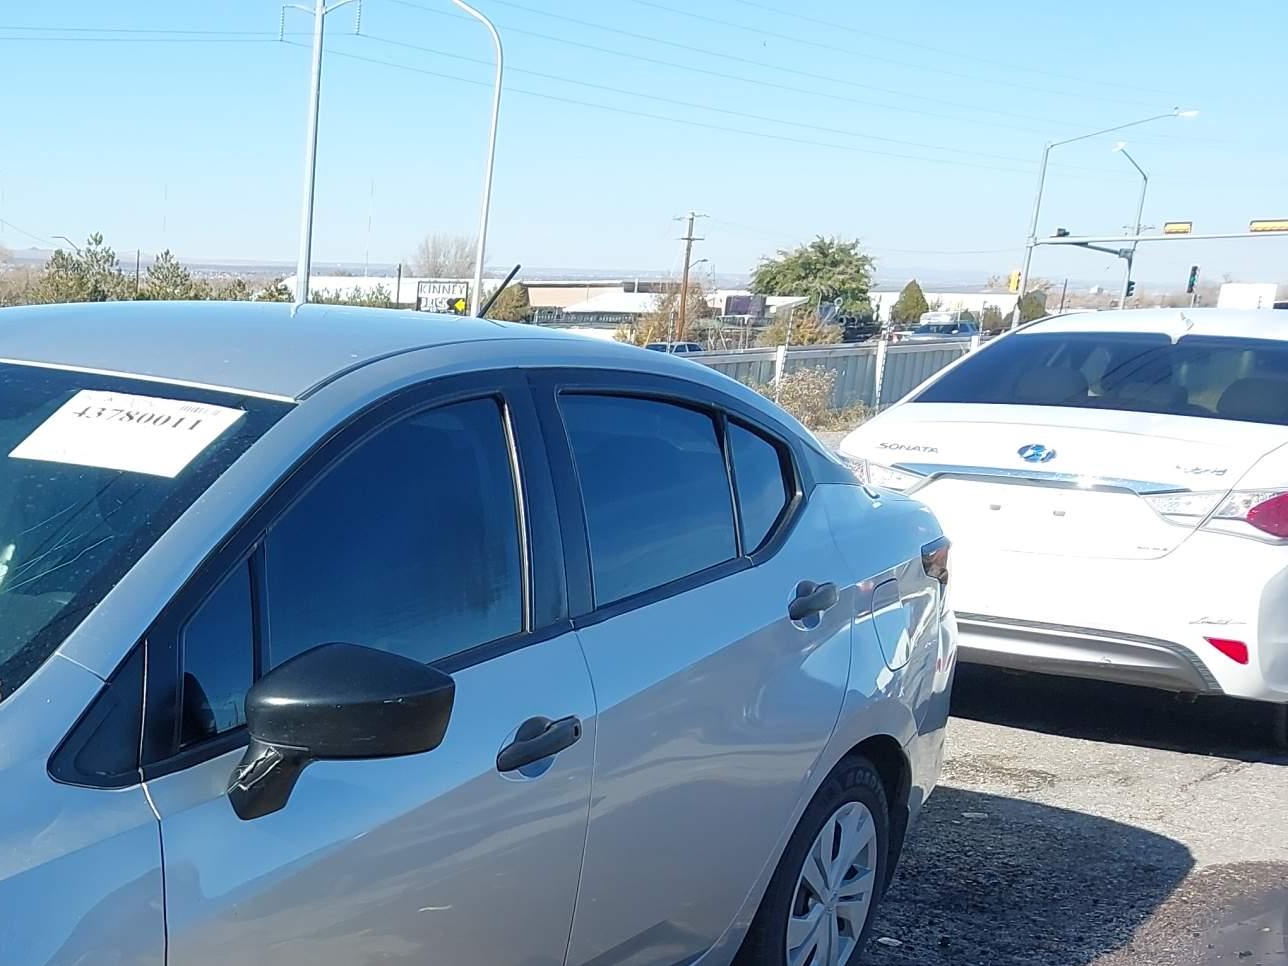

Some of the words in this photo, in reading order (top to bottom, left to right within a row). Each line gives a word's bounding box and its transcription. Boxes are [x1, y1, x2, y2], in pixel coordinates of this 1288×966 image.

[420, 283, 465, 295] KINNEY
[72, 406, 203, 431] 43780011
[879, 442, 939, 454] SONATA
